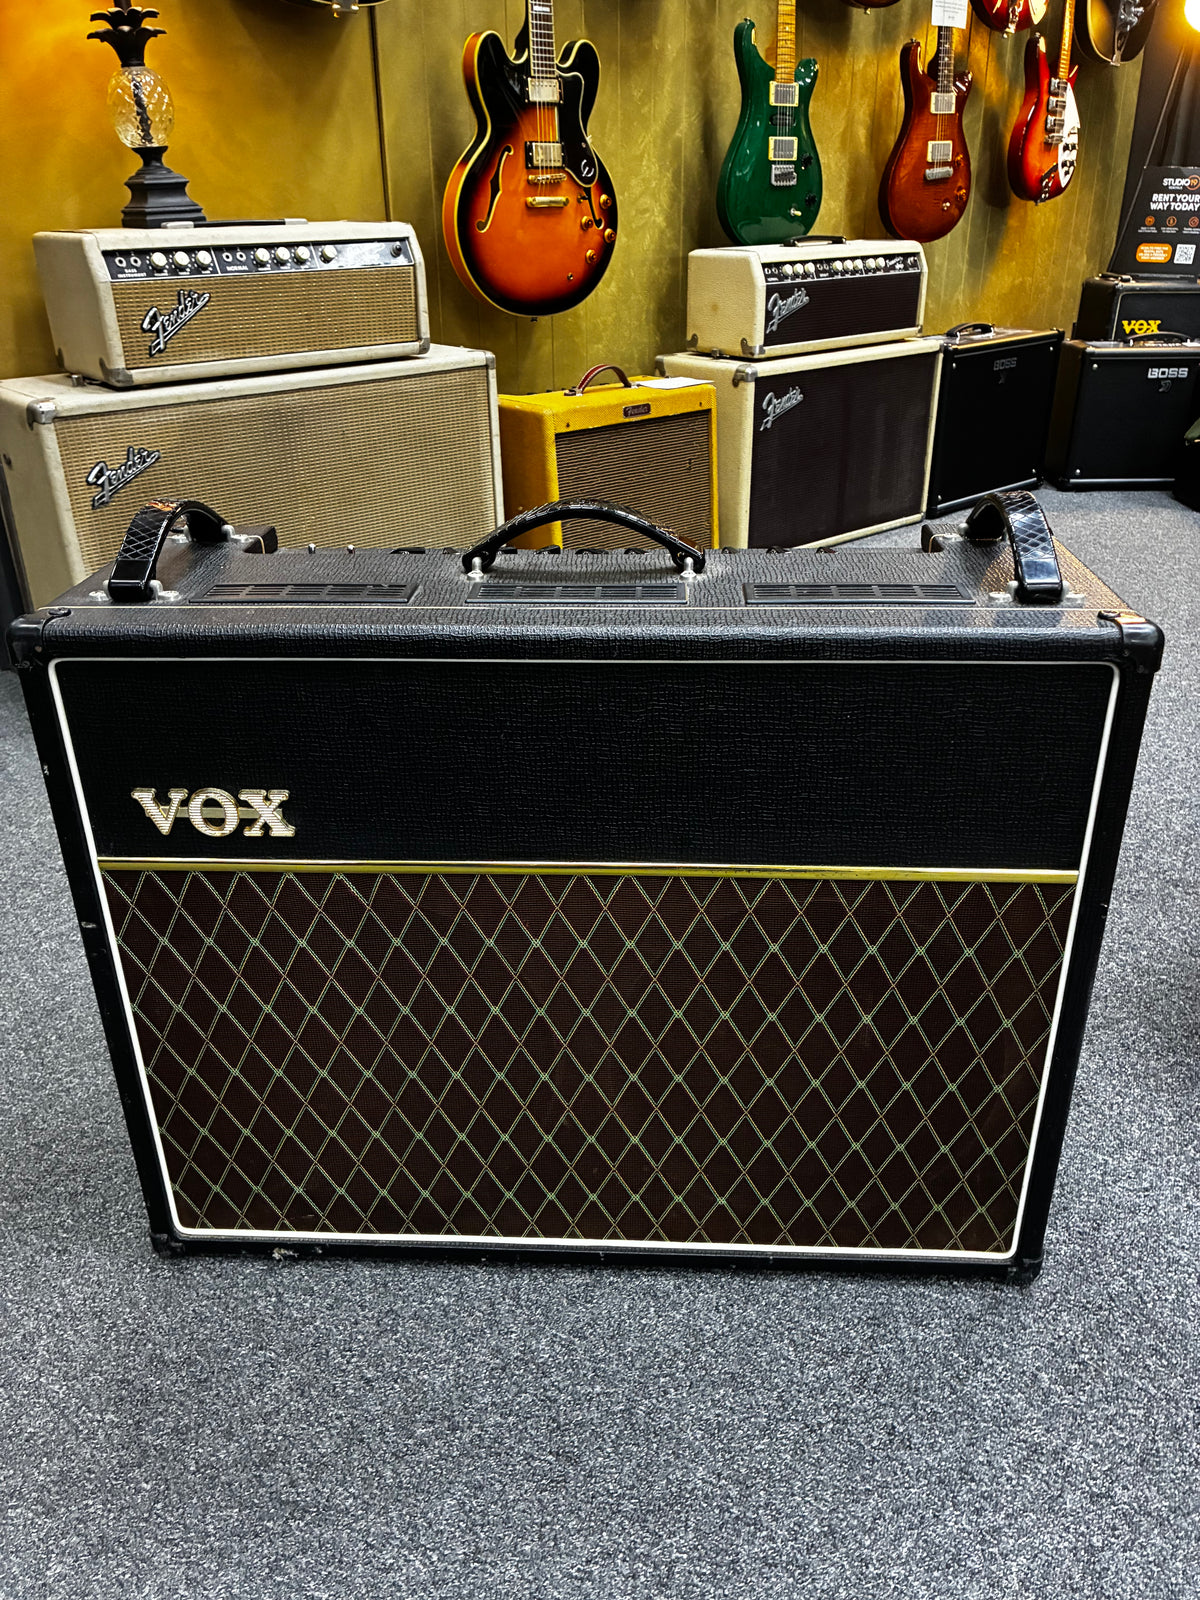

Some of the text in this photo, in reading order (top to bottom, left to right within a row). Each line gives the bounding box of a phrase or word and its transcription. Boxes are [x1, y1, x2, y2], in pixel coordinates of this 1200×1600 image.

[1150, 202, 1200, 211] WAY TODAY
[1152, 193, 1200, 203] RENT YOUR
[141, 289, 211, 357] Fender
[766, 287, 810, 334] Fender
[1121, 320, 1161, 335] VOX
[994, 357, 1017, 371] BOSS
[1147, 367, 1189, 379] BOSS
[759, 386, 804, 432] Fender
[86, 446, 161, 510] Fender
[131, 787, 296, 837] VOX
